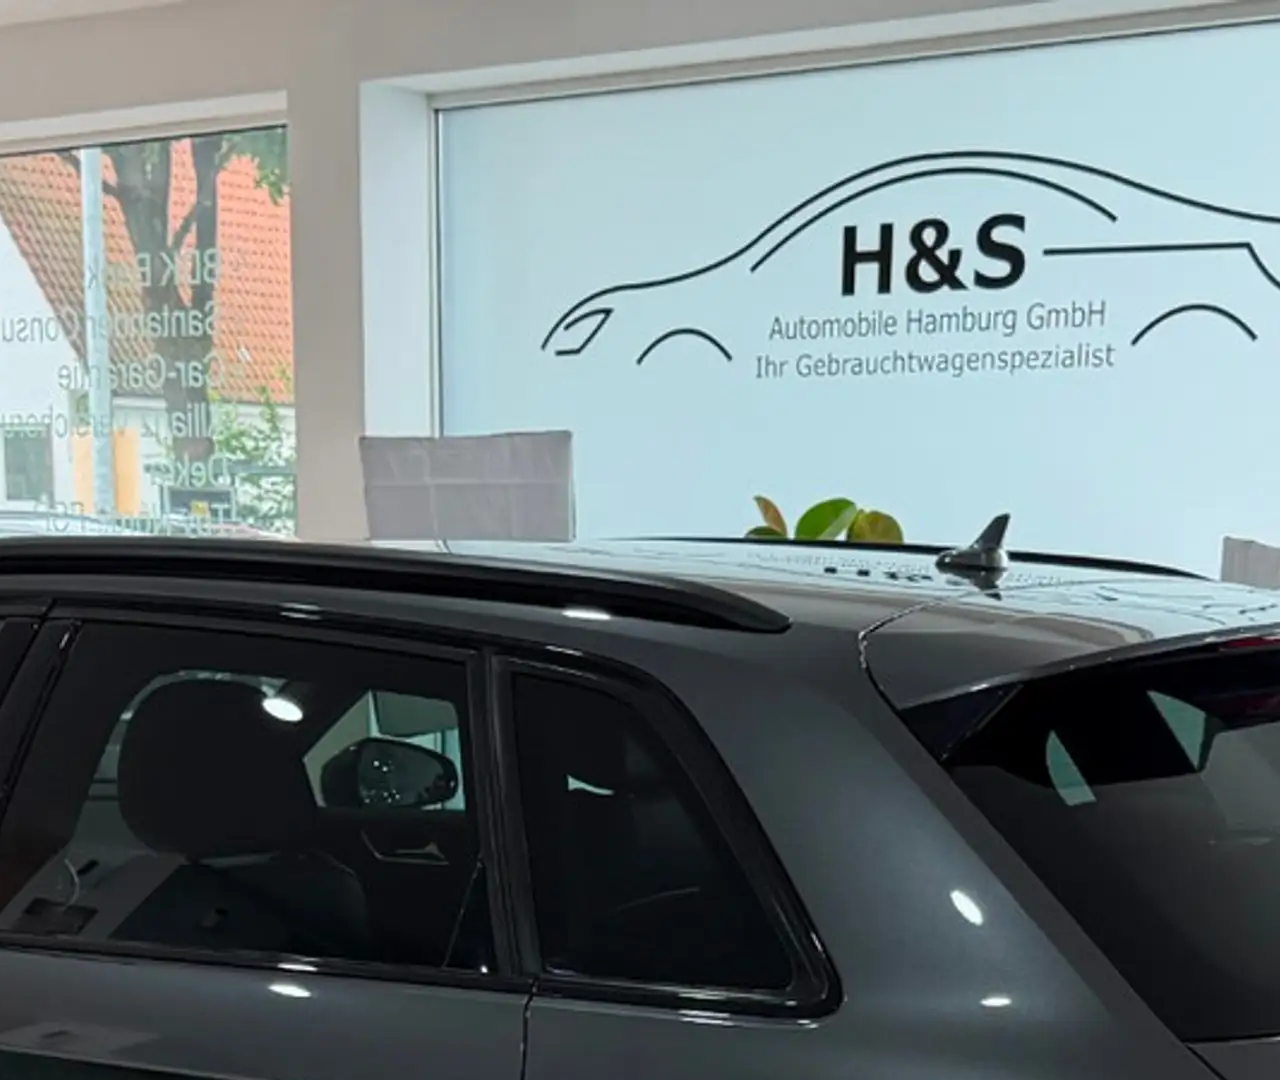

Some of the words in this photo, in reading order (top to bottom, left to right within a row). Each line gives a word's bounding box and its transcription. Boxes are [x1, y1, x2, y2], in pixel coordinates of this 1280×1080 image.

[841, 213, 1026, 297] H&S
[768, 310, 898, 341] Automobile
[906, 304, 1018, 338] Hamburg
[1026, 299, 1107, 331] GmbH
[755, 354, 789, 379] Ihr
[795, 342, 1117, 378] Gebrauchtwagenspezialist
